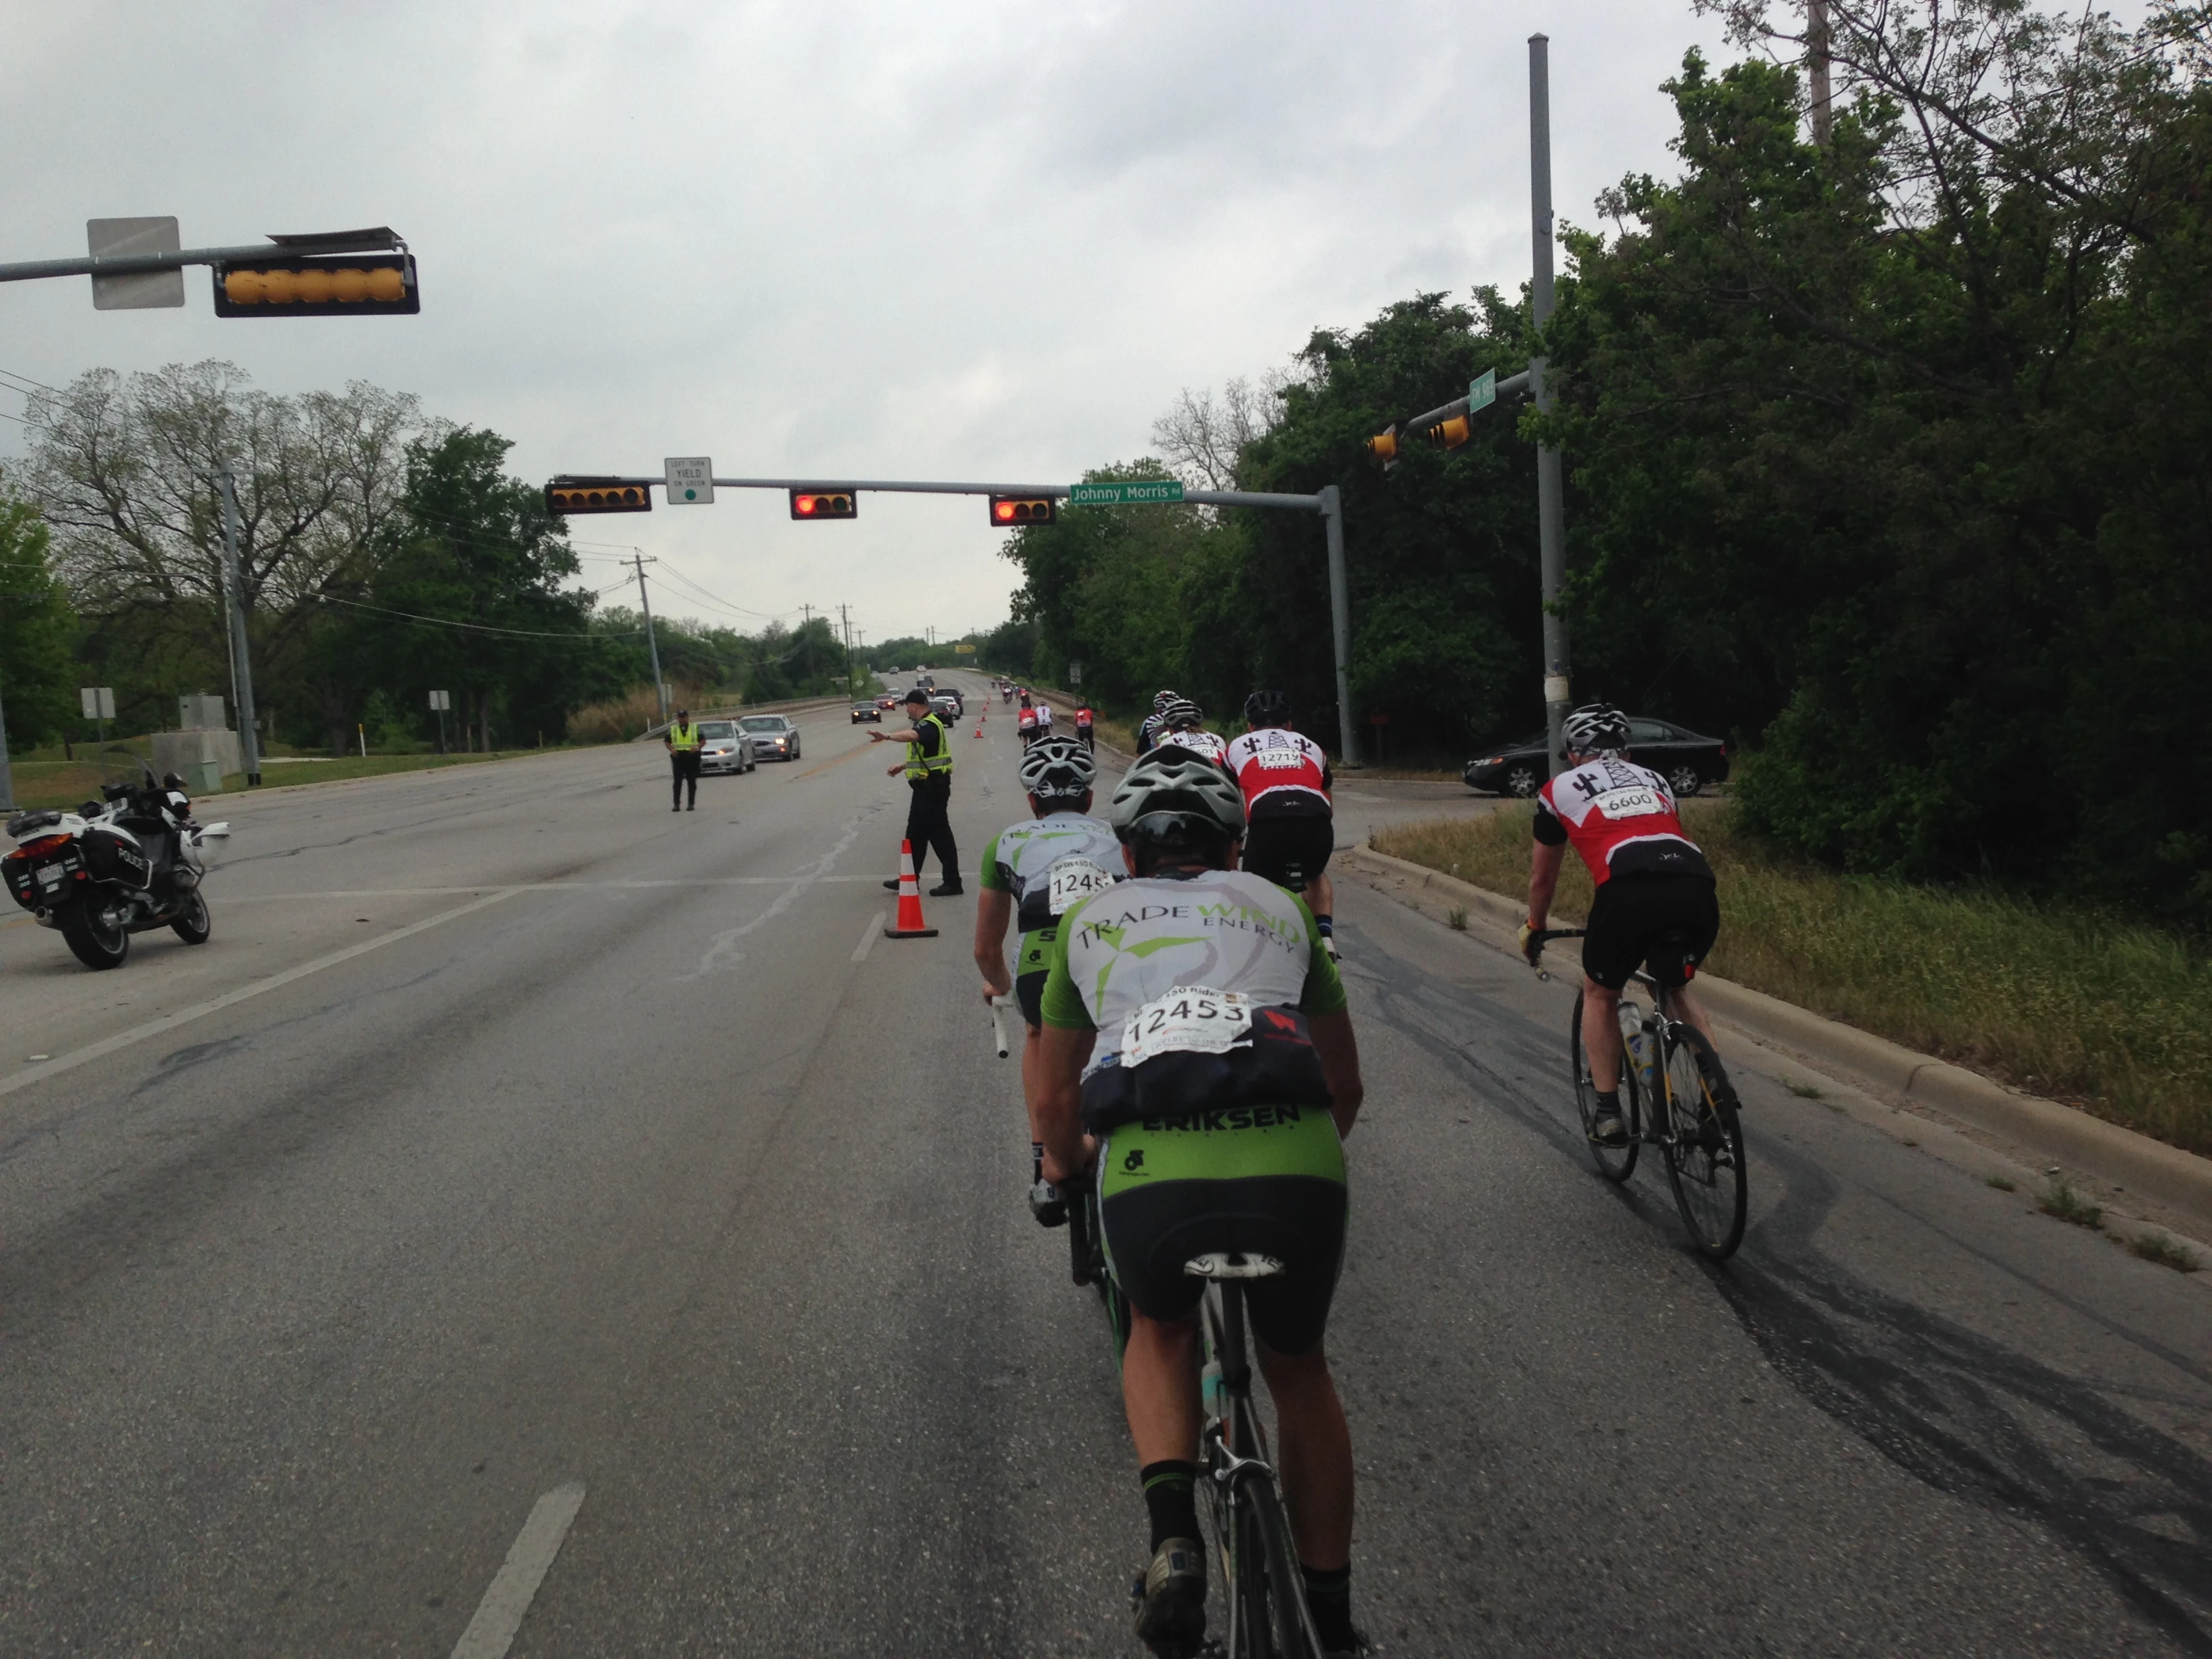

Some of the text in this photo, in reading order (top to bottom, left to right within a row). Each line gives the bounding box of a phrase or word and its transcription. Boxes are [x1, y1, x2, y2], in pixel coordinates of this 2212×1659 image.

[676, 469, 701, 478] YIELD
[1073, 485, 1181, 501] Johnny Morris Rd
[1609, 794, 1652, 811] 6600
[118, 847, 144, 871] POLICE
[1053, 874, 1109, 895] 1245
[1076, 903, 1300, 949] TRADE WIND
[1204, 917, 1294, 954] ENERGY
[1128, 1000, 1244, 1042] 12453
[1143, 1104, 1300, 1131] ERIKSEN
